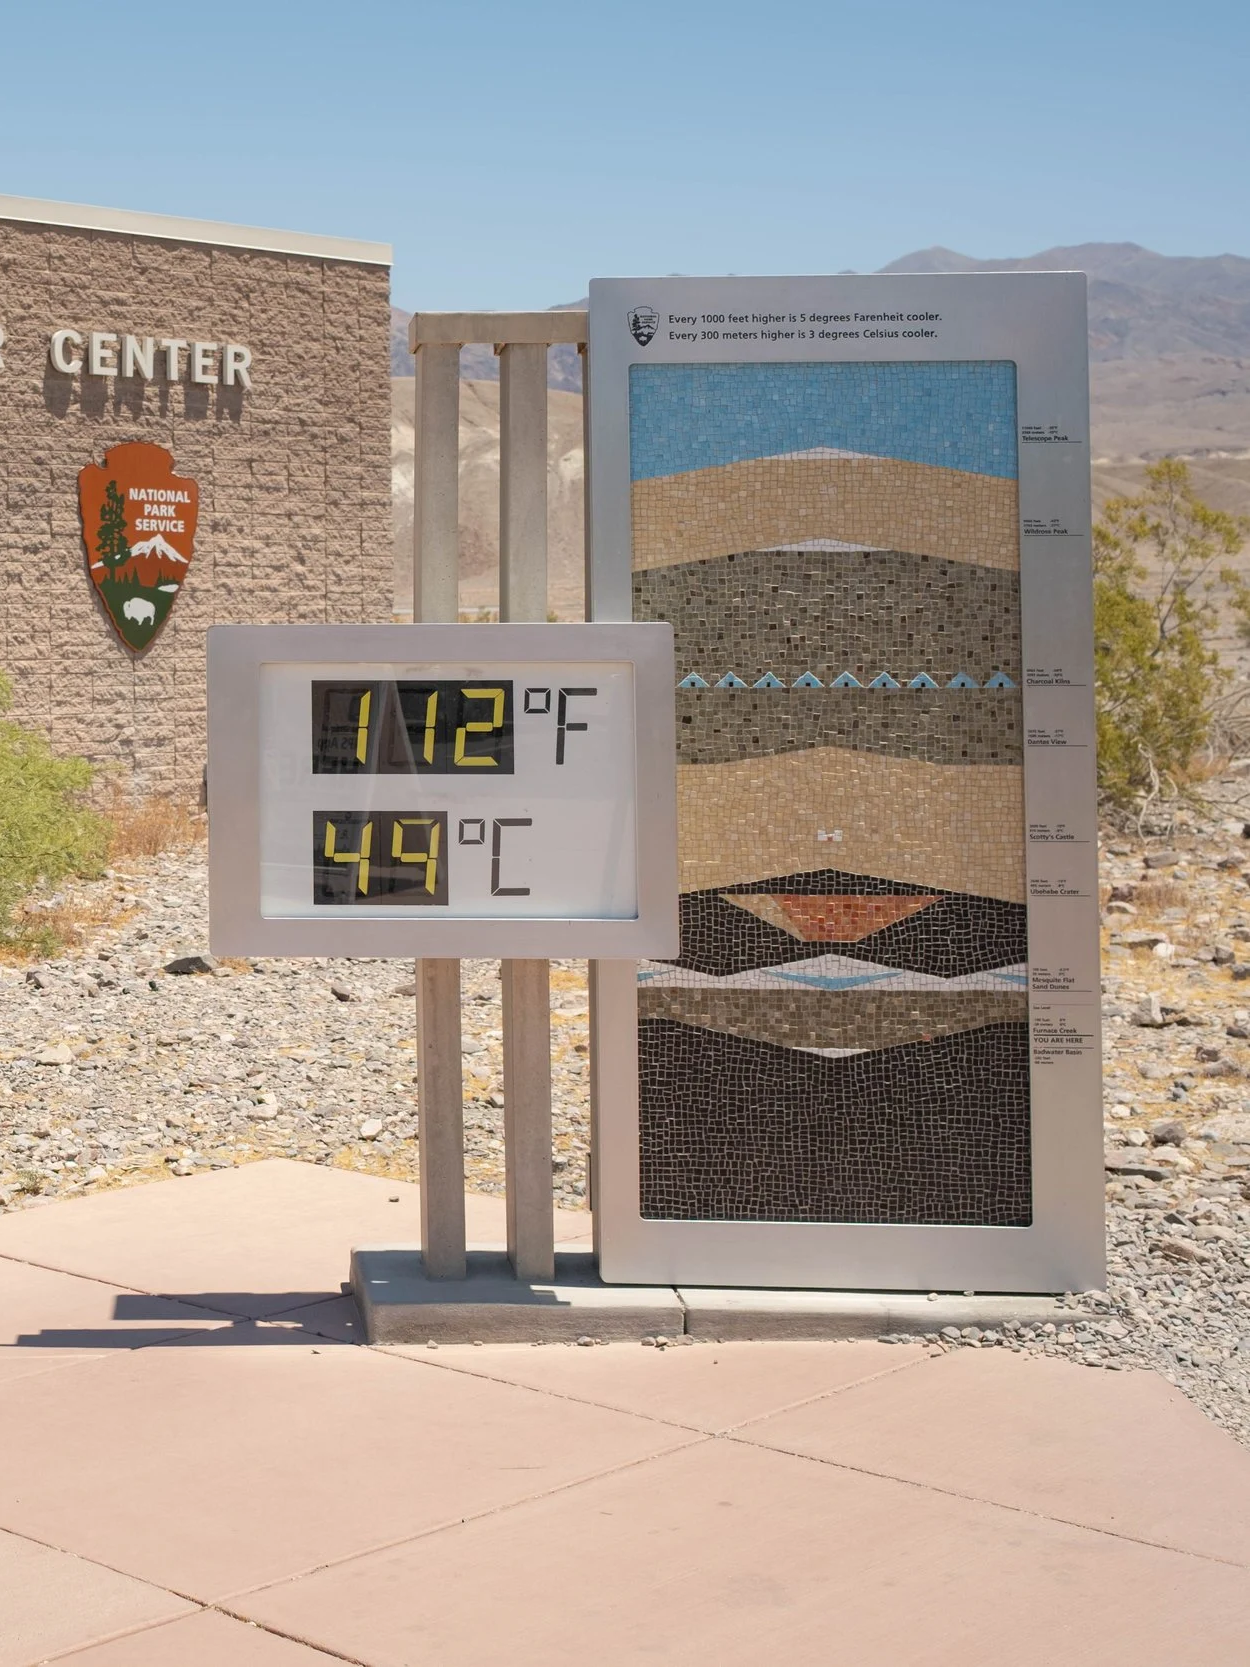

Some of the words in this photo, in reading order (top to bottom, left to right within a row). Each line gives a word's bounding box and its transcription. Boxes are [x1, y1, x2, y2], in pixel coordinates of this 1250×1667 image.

[669, 314, 698, 325] Every
[701, 314, 725, 323] 1000
[728, 313, 749, 323] feet
[752, 313, 786, 325] higher
[789, 313, 797, 323] is
[800, 313, 807, 323] 5
[809, 313, 851, 325] degrees
[853, 312, 904, 322] Farenheit
[907, 312, 943, 322] cooler.
[669, 331, 698, 342] Every
[701, 331, 720, 340] 300
[723, 331, 758, 340] meters
[761, 330, 795, 342] higher
[798, 330, 806, 339] is
[809, 330, 815, 339] 3
[818, 330, 860, 341] degrees
[863, 329, 899, 339] Celsius
[902, 329, 938, 339] cooler.
[50, 328, 254, 390] CENTER
[1021, 435, 1052, 443] Telescope
[129, 487, 191, 504] NATIONAL
[143, 503, 176, 518] PARK
[135, 518, 185, 534] SERVICE
[356, 688, 505, 766] 112
[1029, 833, 1055, 841] Scotty's
[324, 819, 440, 897] 49
[1032, 976, 1062, 985] Mesquite
